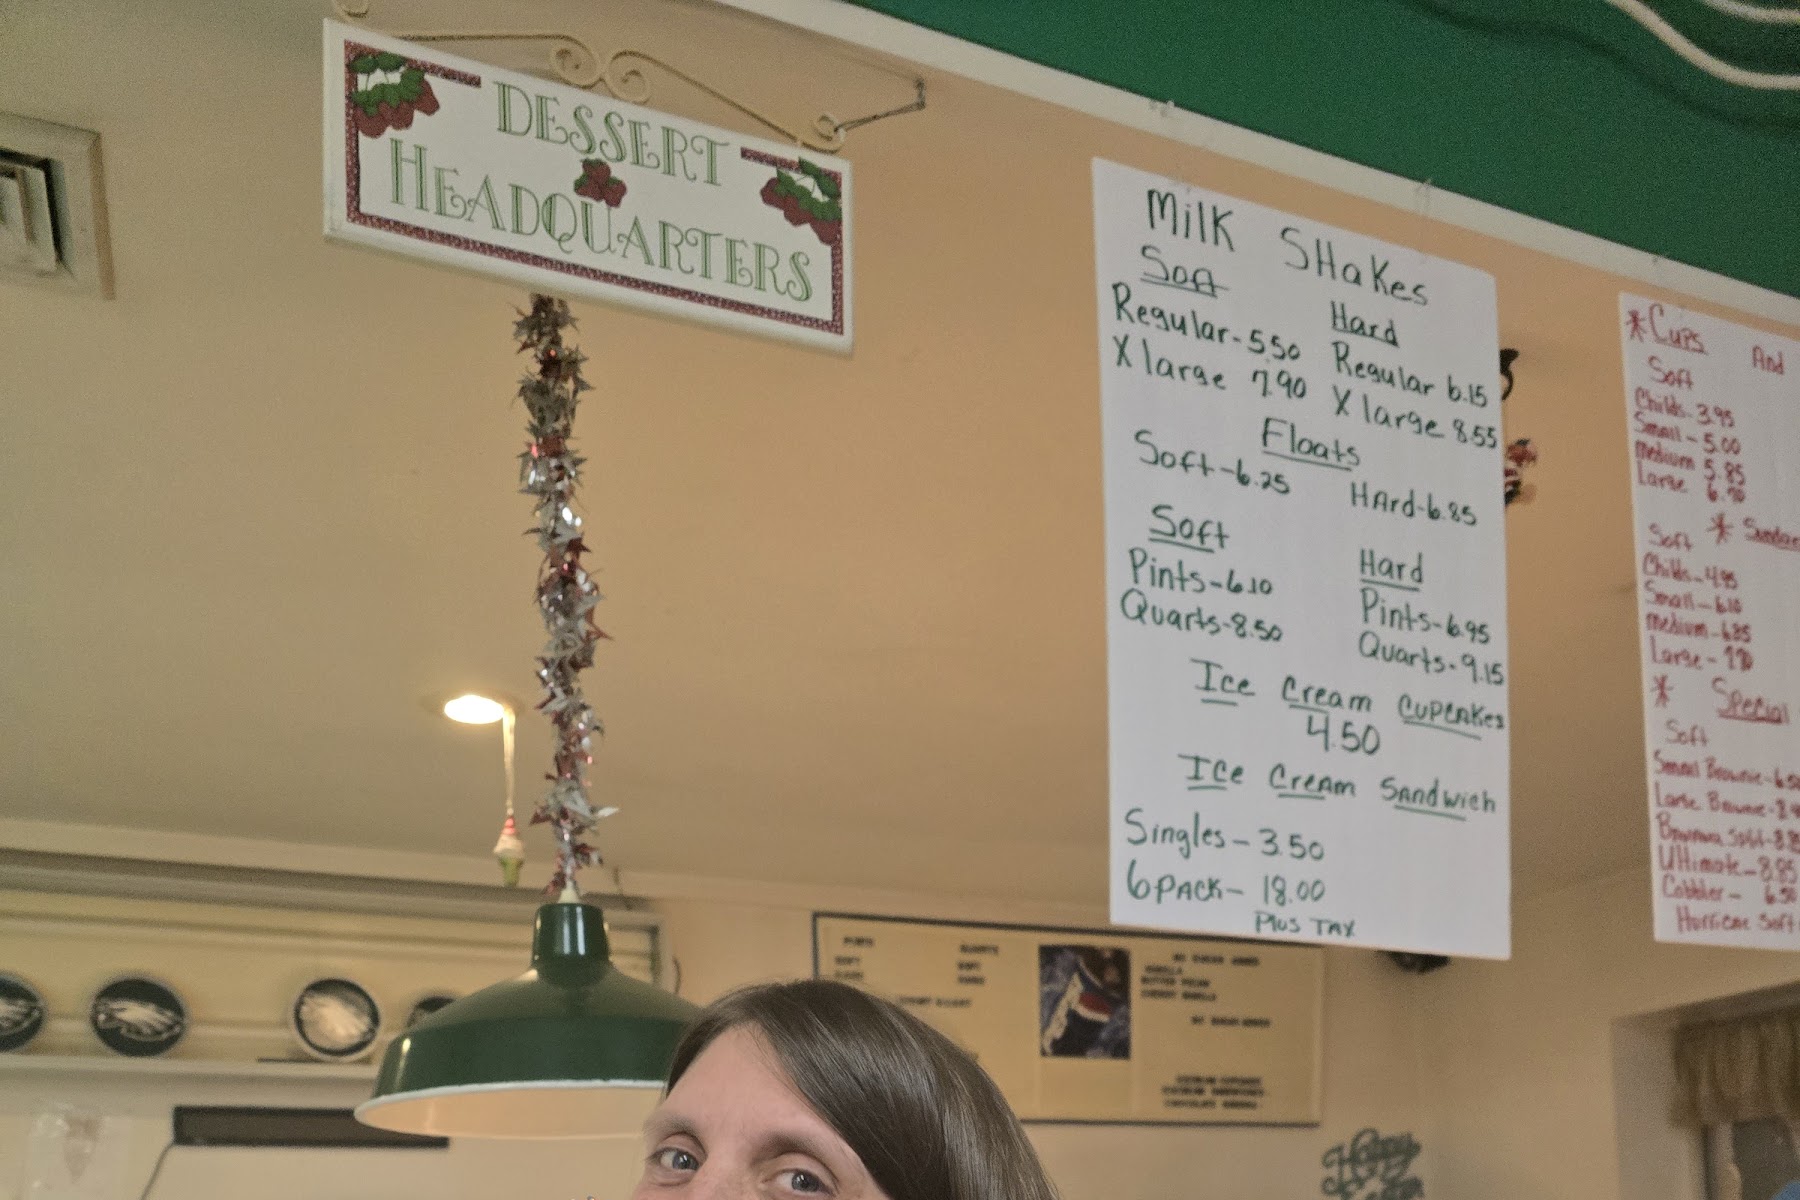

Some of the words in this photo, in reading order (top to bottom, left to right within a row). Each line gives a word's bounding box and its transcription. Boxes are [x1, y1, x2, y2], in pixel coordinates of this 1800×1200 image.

[493, 81, 730, 187] DESSERT
[389, 138, 813, 303] HEADQUARTERS
[1331, 300, 1399, 347] Hard
[1332, 340, 1435, 396] Regular
[1261, 416, 1361, 468] Floats
[1149, 504, 1230, 550] Soft
[1360, 549, 1424, 586] Hard
[1190, 657, 1256, 697] Ice
[1282, 674, 1372, 712] Cream
[1307, 714, 1381, 755] 4.50
[1263, 874, 1326, 907] 18.00
[1310, 918, 1358, 938] TAX
